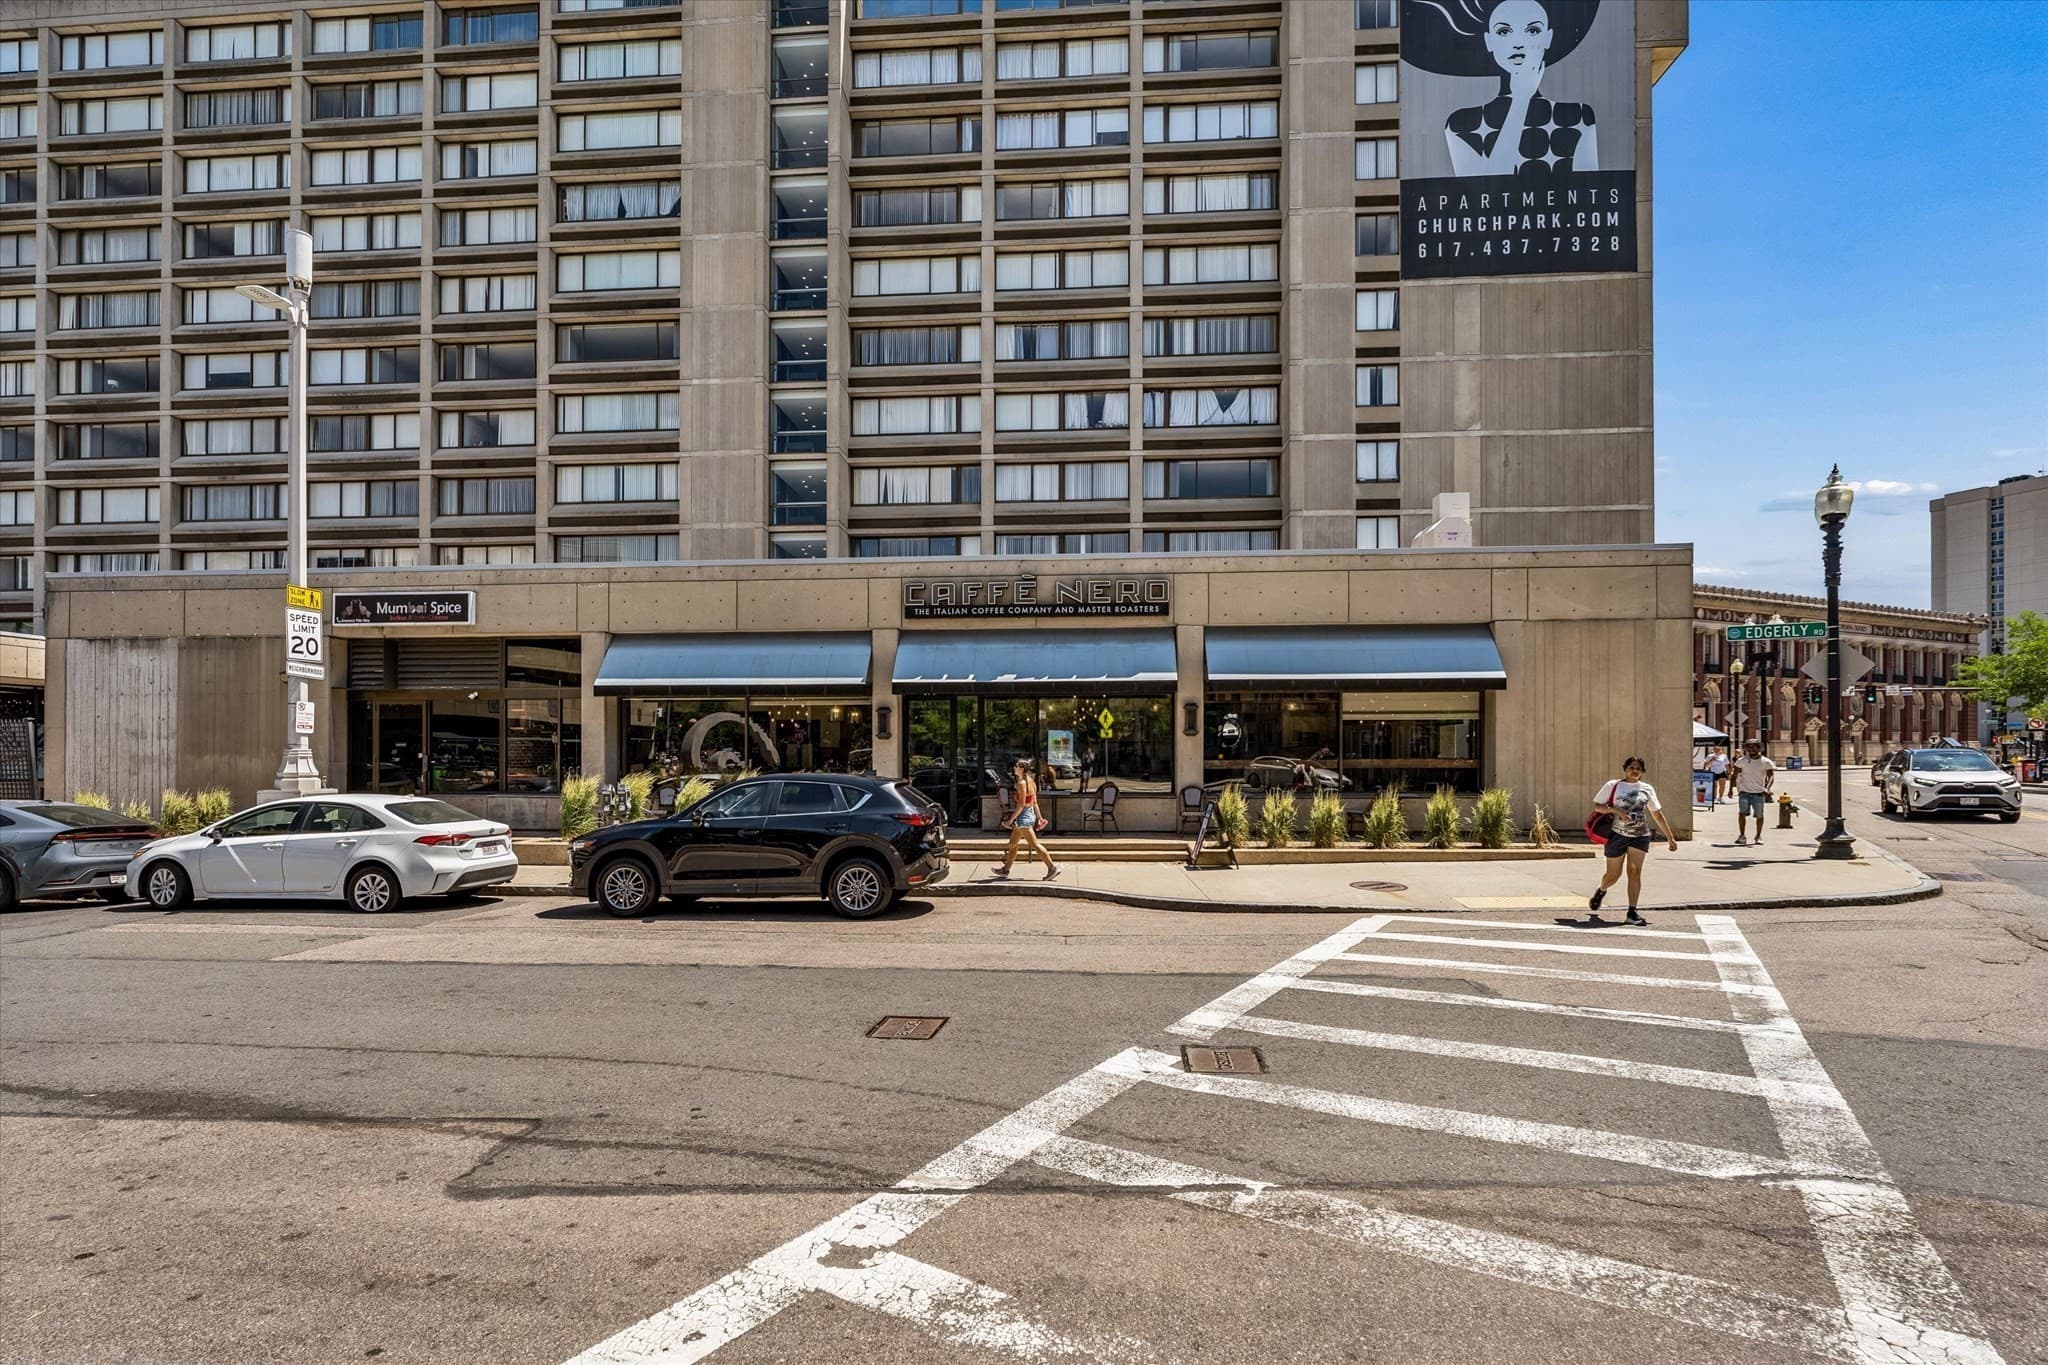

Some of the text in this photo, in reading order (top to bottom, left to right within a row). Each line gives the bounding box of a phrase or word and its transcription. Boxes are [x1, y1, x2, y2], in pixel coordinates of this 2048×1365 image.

[1418, 188, 1619, 212] APARTMENTS
[1418, 211, 1619, 234] CHURCHPARK.COM
[1418, 236, 1619, 258] 617.437.7328
[289, 588, 306, 597] SLOW
[904, 574, 1169, 606] CAFFÈ NERO
[290, 597, 306, 605] ZONE
[376, 601, 462, 615] Mumbai Spice
[914, 604, 1160, 616] THE ITALIAN COFFEE COMPANY AND MASTER ROASTERS
[289, 613, 319, 625] SPEED
[293, 623, 316, 635] LIMIT
[1745, 624, 1809, 639] EDGERLY
[291, 635, 319, 656] 20
